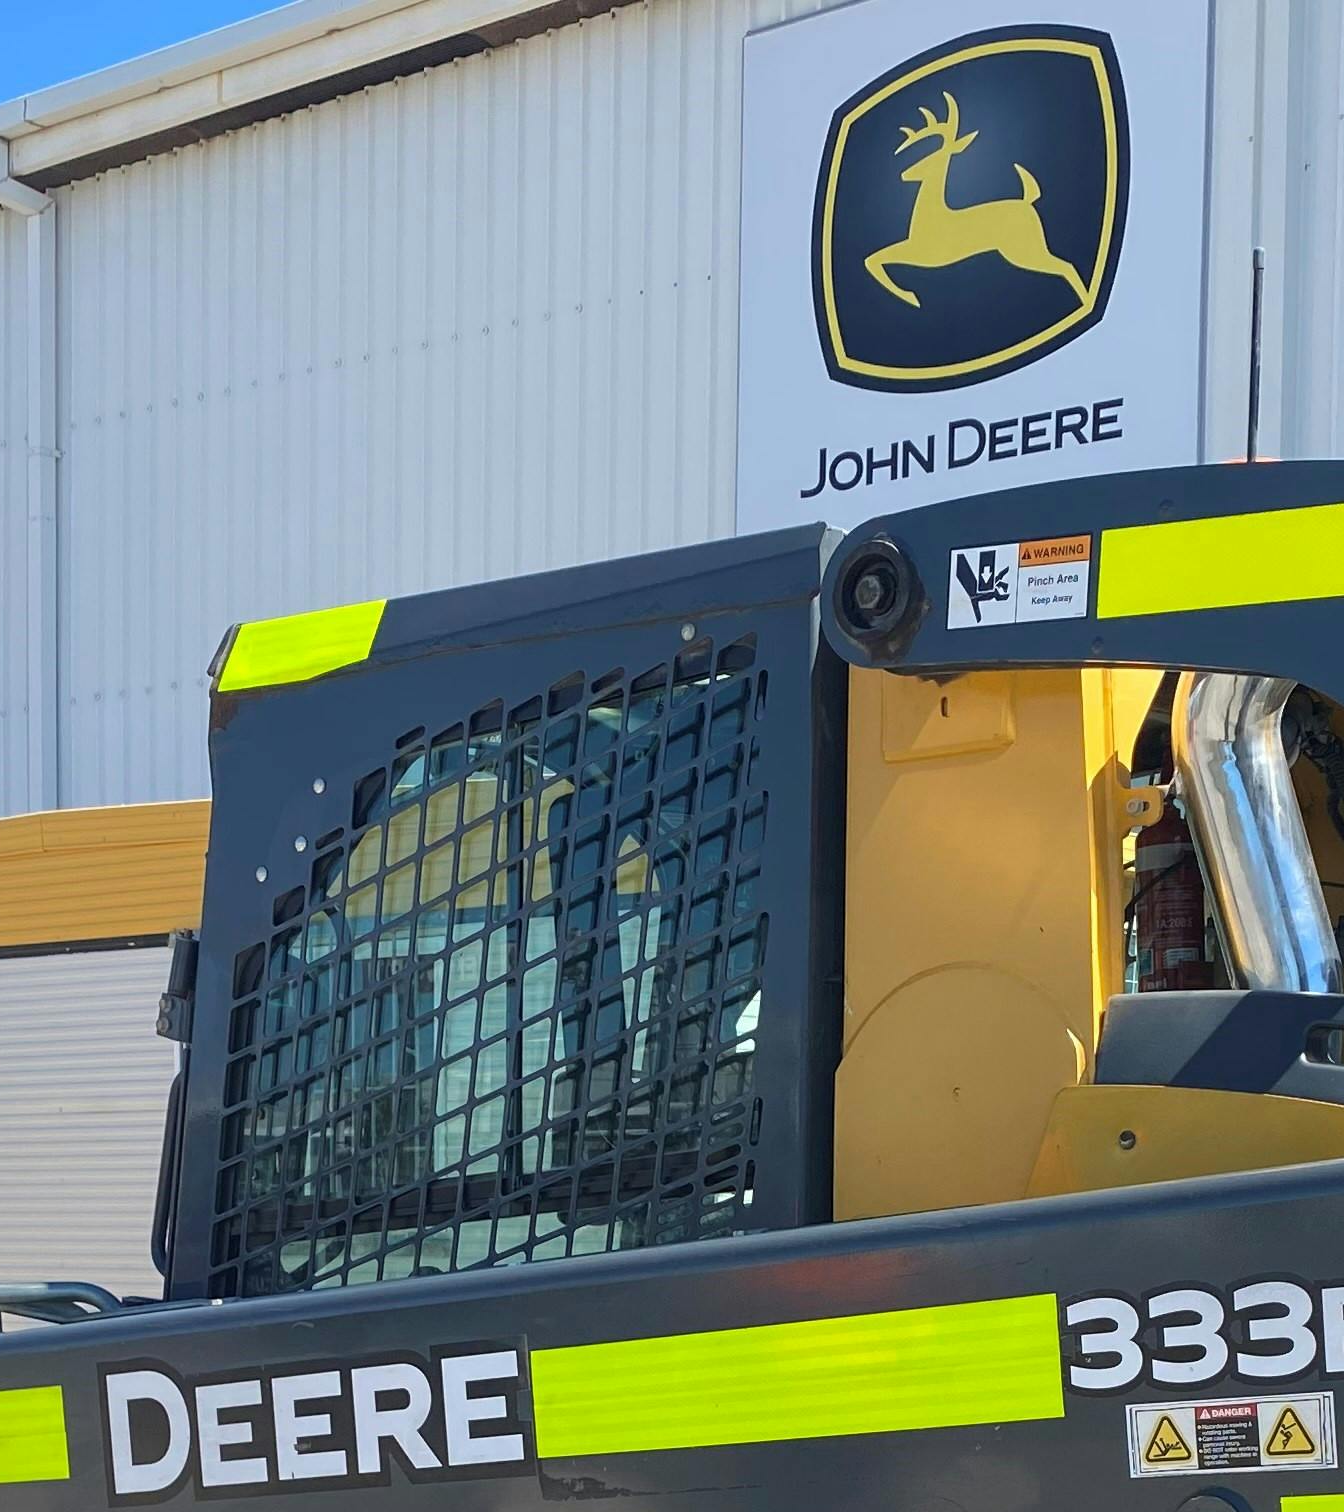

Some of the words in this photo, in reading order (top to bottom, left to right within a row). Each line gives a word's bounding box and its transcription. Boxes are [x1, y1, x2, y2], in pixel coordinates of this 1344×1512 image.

[799, 433, 935, 498] JOHN
[947, 397, 1124, 470] DEERE
[1033, 543, 1084, 559] WARNING
[1028, 575, 1054, 587] Pinch
[1056, 573, 1079, 584] Area
[1031, 596, 1051, 606] Keep
[1052, 594, 1073, 604] Away
[1211, 1407, 1252, 1418] DANGER
[103, 1349, 525, 1496] DEERE
